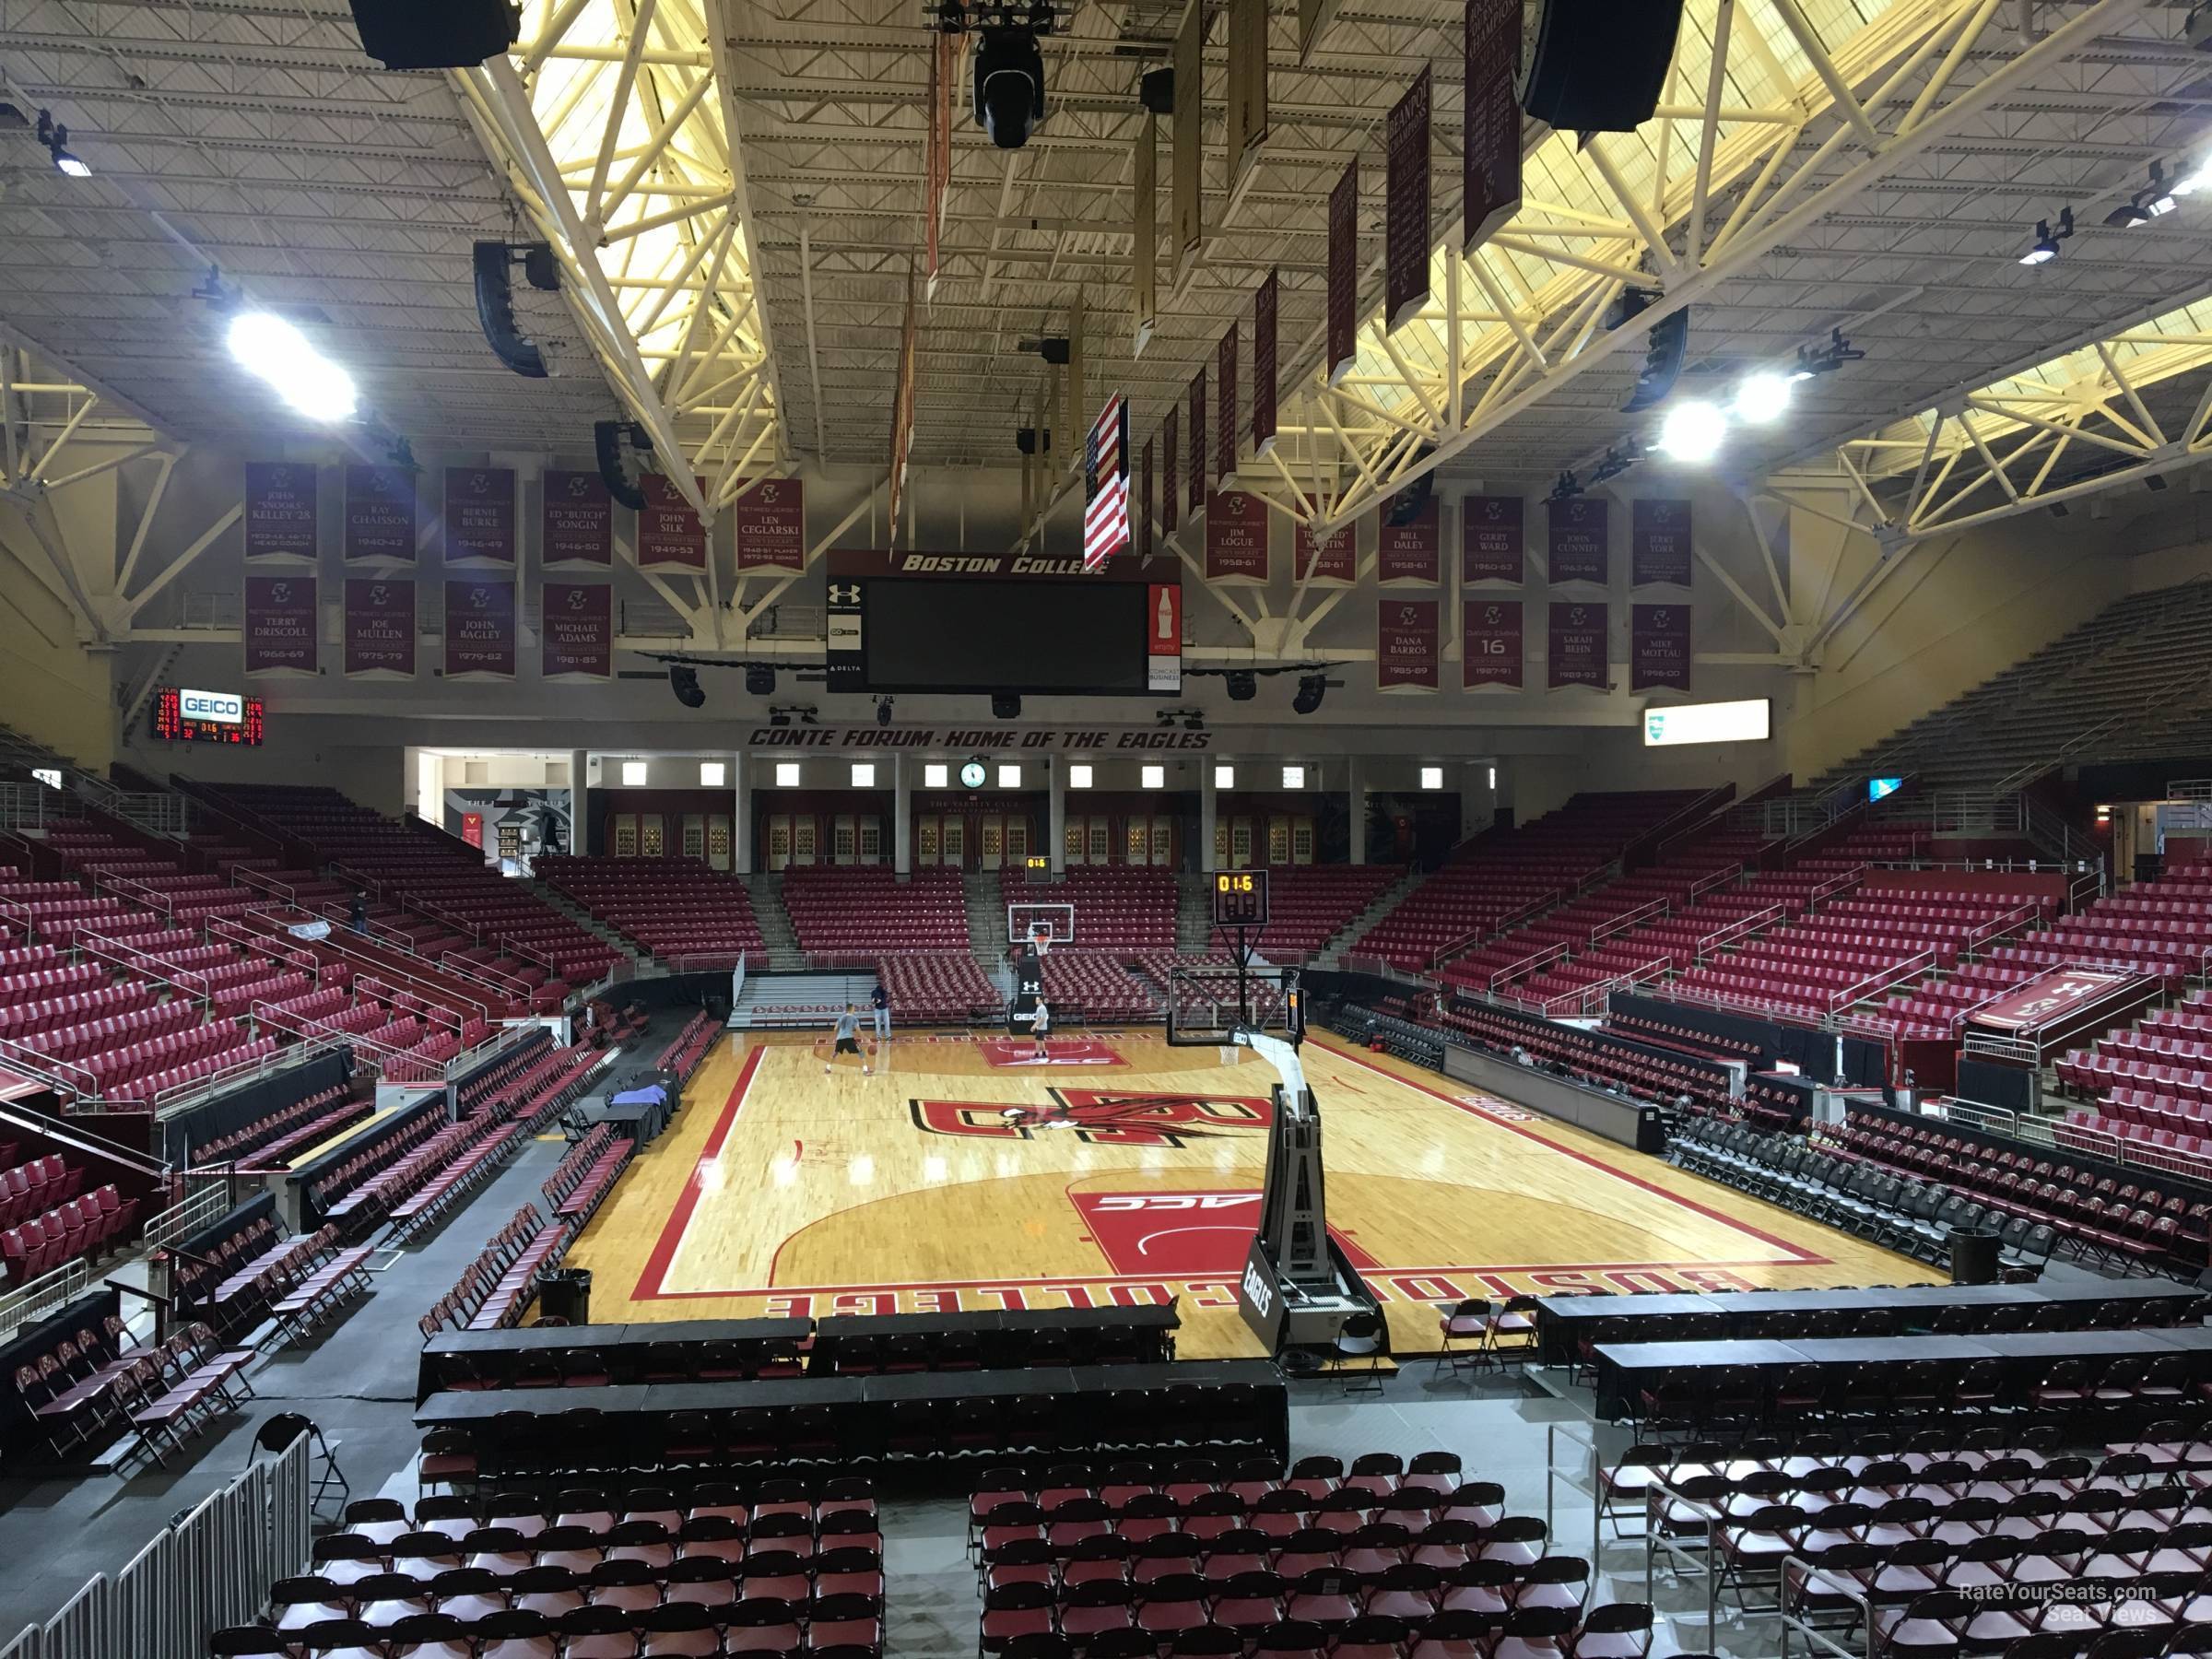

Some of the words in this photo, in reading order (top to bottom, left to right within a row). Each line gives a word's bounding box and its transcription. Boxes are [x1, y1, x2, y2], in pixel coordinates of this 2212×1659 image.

[253, 510, 292, 519] KELLEY
[463, 508, 498, 517] BERNIE
[548, 511, 561, 519] ED
[352, 515, 408, 524] CHAISSON
[463, 518, 499, 527] BURKE
[659, 513, 685, 524] JOHN
[761, 516, 779, 524] LEN
[557, 521, 598, 530] SONGIN
[661, 524, 684, 534] SILK
[741, 525, 799, 535] CEGLARSKI
[1230, 528, 1244, 537] JIM
[1400, 532, 1418, 540] BILL
[1221, 537, 1254, 547] LOGUE
[1394, 540, 1424, 550] DALEY
[1479, 542, 1510, 551] WARD
[651, 545, 694, 554] 1949-53
[902, 554, 1002, 572] BOSTON
[265, 618, 297, 627] TERRY
[371, 618, 388, 629] JOE
[465, 619, 495, 630] JOHN
[554, 622, 598, 632] MICHAEL
[254, 627, 308, 637] DRISCOLL
[357, 628, 403, 638] MULLEN
[460, 629, 500, 640] BAGLEY
[558, 633, 597, 642] ADAMS
[1395, 636, 1422, 645] DANA
[1563, 635, 1593, 644] SARAH
[1481, 640, 1505, 654] 16
[1565, 644, 1591, 654] BEHN
[1651, 640, 1673, 649] MIKE
[1390, 645, 1427, 654] BARROS
[1641, 649, 1681, 658] MOTTAU
[358, 652, 403, 661] 1975-79
[458, 652, 502, 661] 1979-82
[185, 698, 239, 715] GEICO
[747, 729, 837, 747] CONTE
[841, 730, 935, 747] FORUM
[943, 731, 1018, 747] HOME
[1020, 731, 1056, 747] OF
[1062, 732, 1109, 747] THE
[1116, 732, 1212, 748] EAGLES
[1243, 1260, 1272, 1318] EAGLES
